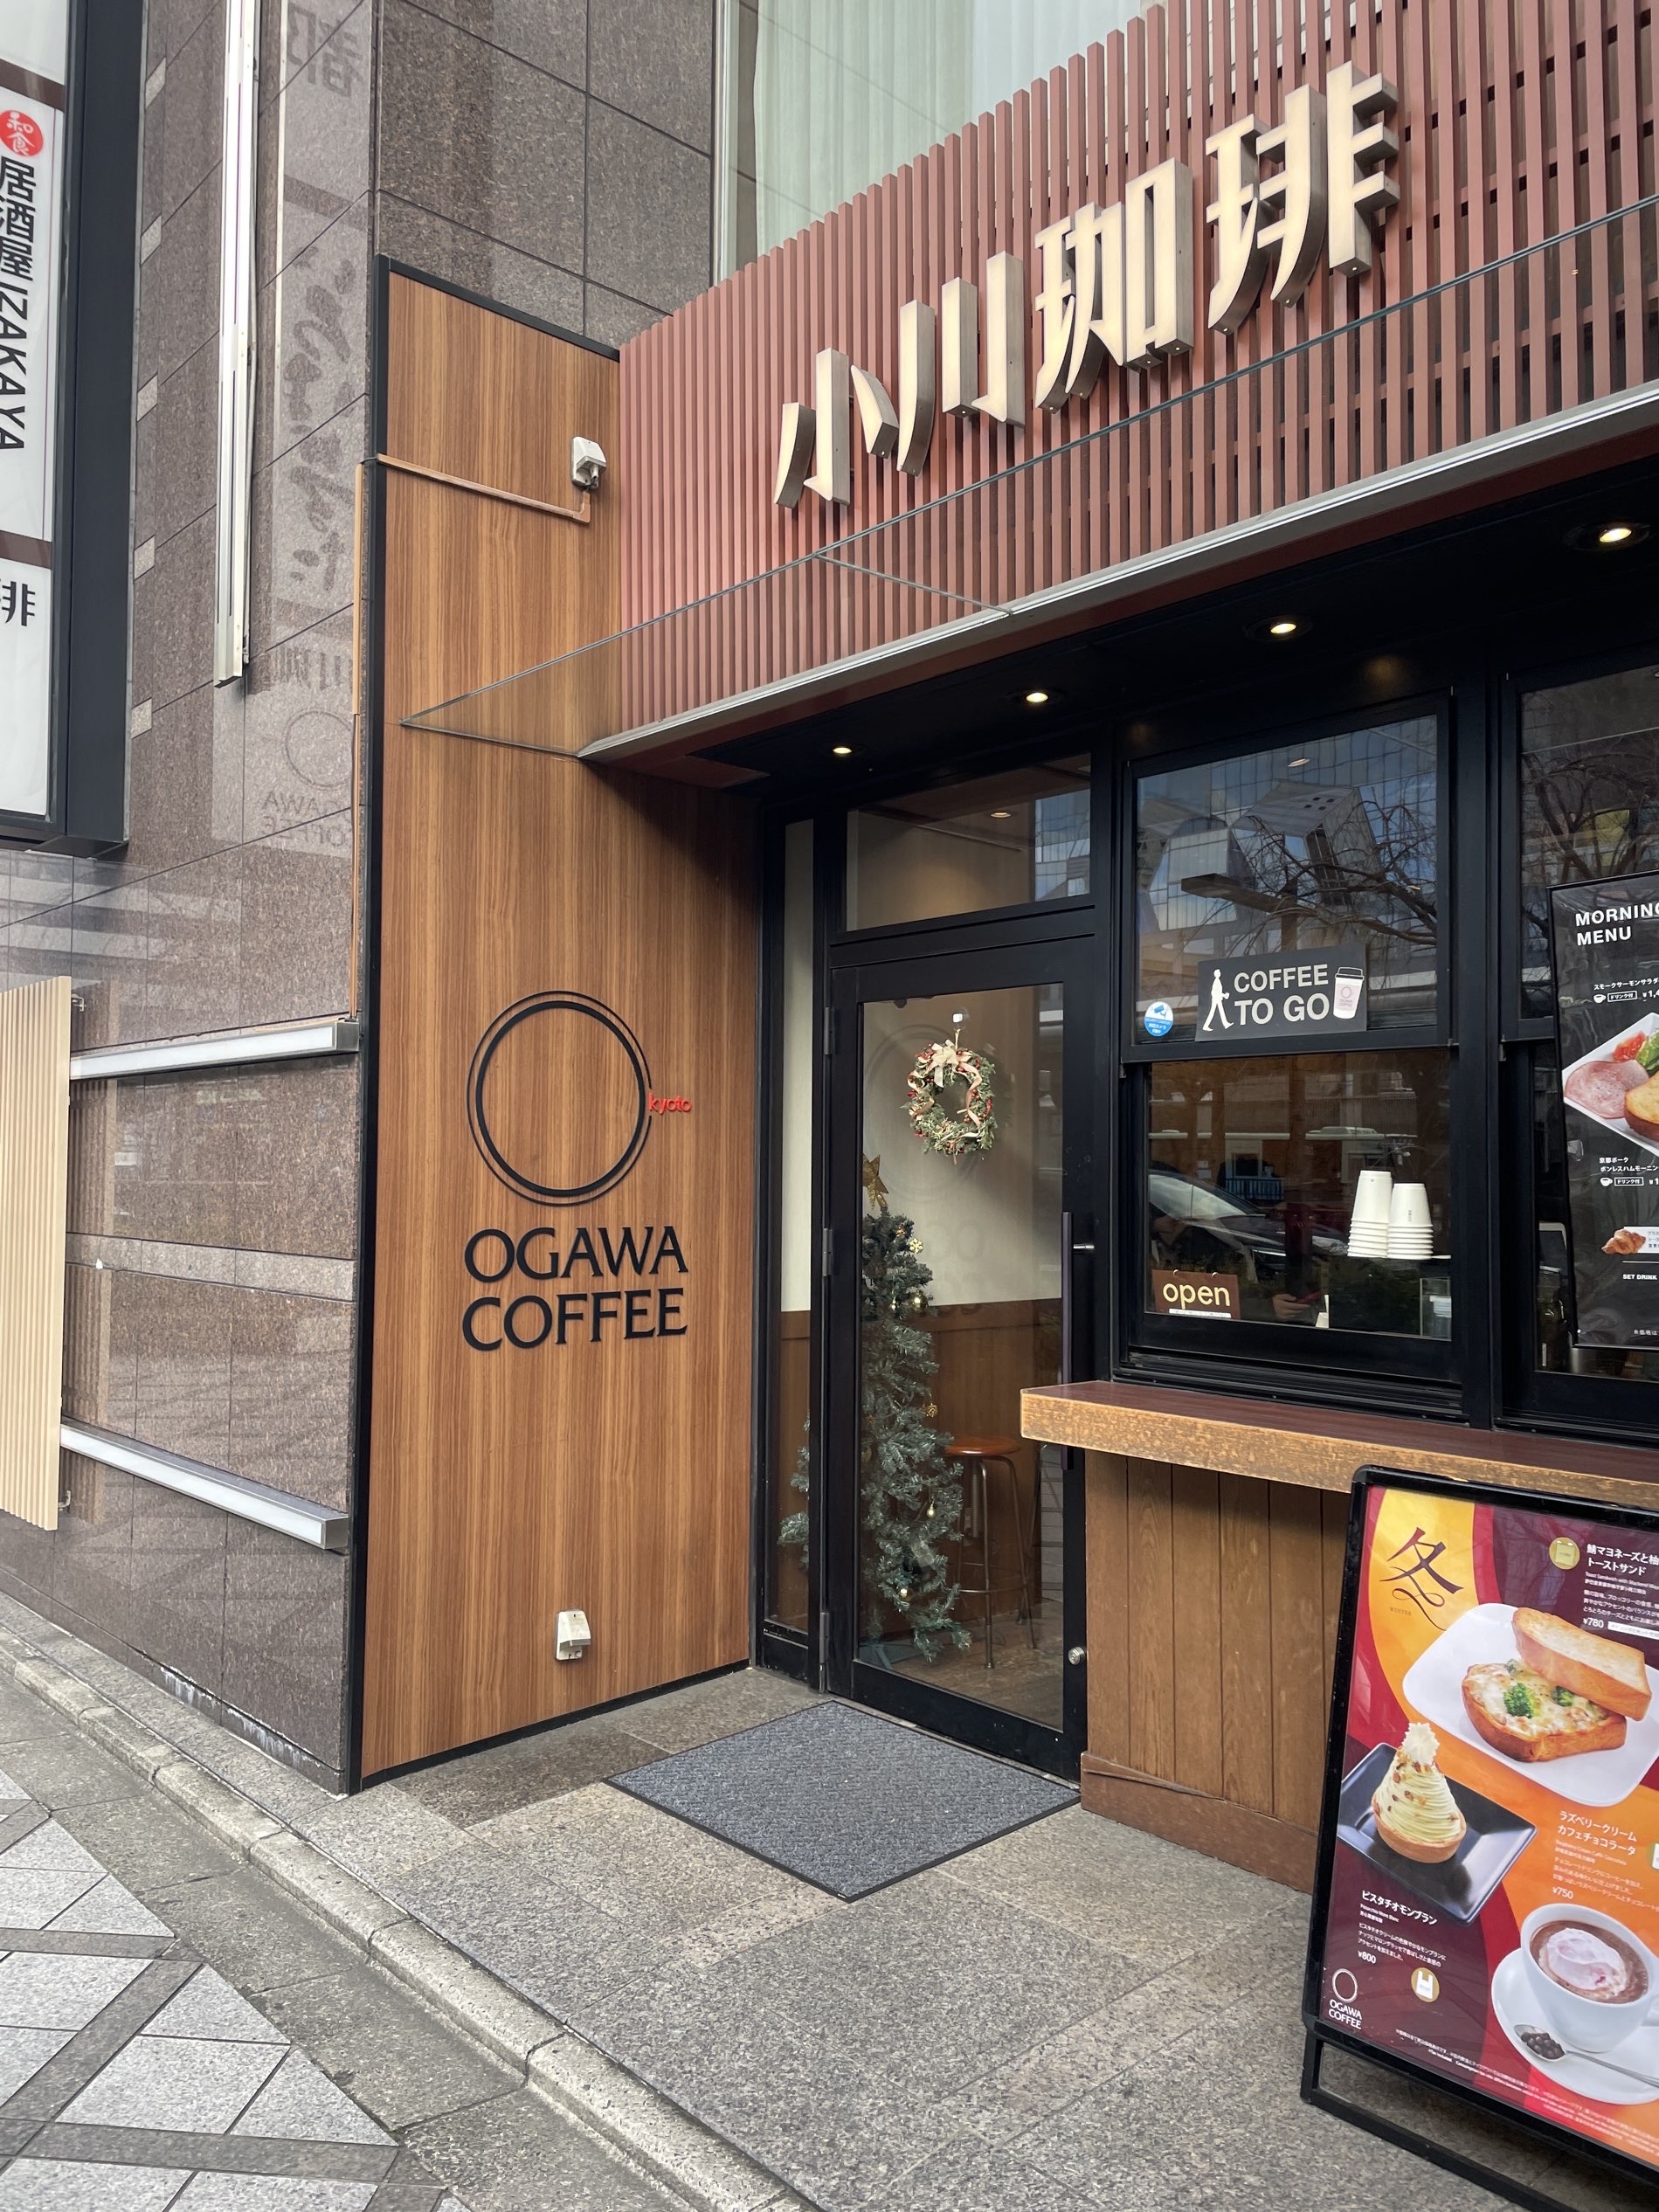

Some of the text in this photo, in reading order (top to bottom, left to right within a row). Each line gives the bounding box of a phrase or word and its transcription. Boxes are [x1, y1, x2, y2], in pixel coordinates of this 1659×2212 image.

[773, 60, 1400, 508] 小川珈琲
[0, 156, 37, 450] 居酒屋 IZAKAYA
[1577, 926, 1632, 946] MENU
[1234, 964, 1329, 993] COFFEE
[1234, 992, 1330, 1026] TO GO
[648, 1091, 692, 1115] kyoto
[465, 1226, 688, 1282] OGAWA
[1163, 1283, 1230, 1310] open
[462, 1288, 688, 1351] COFFEE
[1588, 1558, 1646, 1576] トーストサンド
[1583, 1618, 1605, 1628] ¥780
[1559, 1810, 1637, 1842] ラズベリークリーム
[1558, 1825, 1636, 1856] カフェチョコラータ
[1552, 1887, 1573, 1899] ¥750
[1362, 1890, 1438, 1925] ピスタチオモンブラン
[1358, 1951, 1377, 1964] ¥800
[1328, 2008, 1362, 2030] COFFEE
[1329, 1999, 1362, 2020] OGAWA
